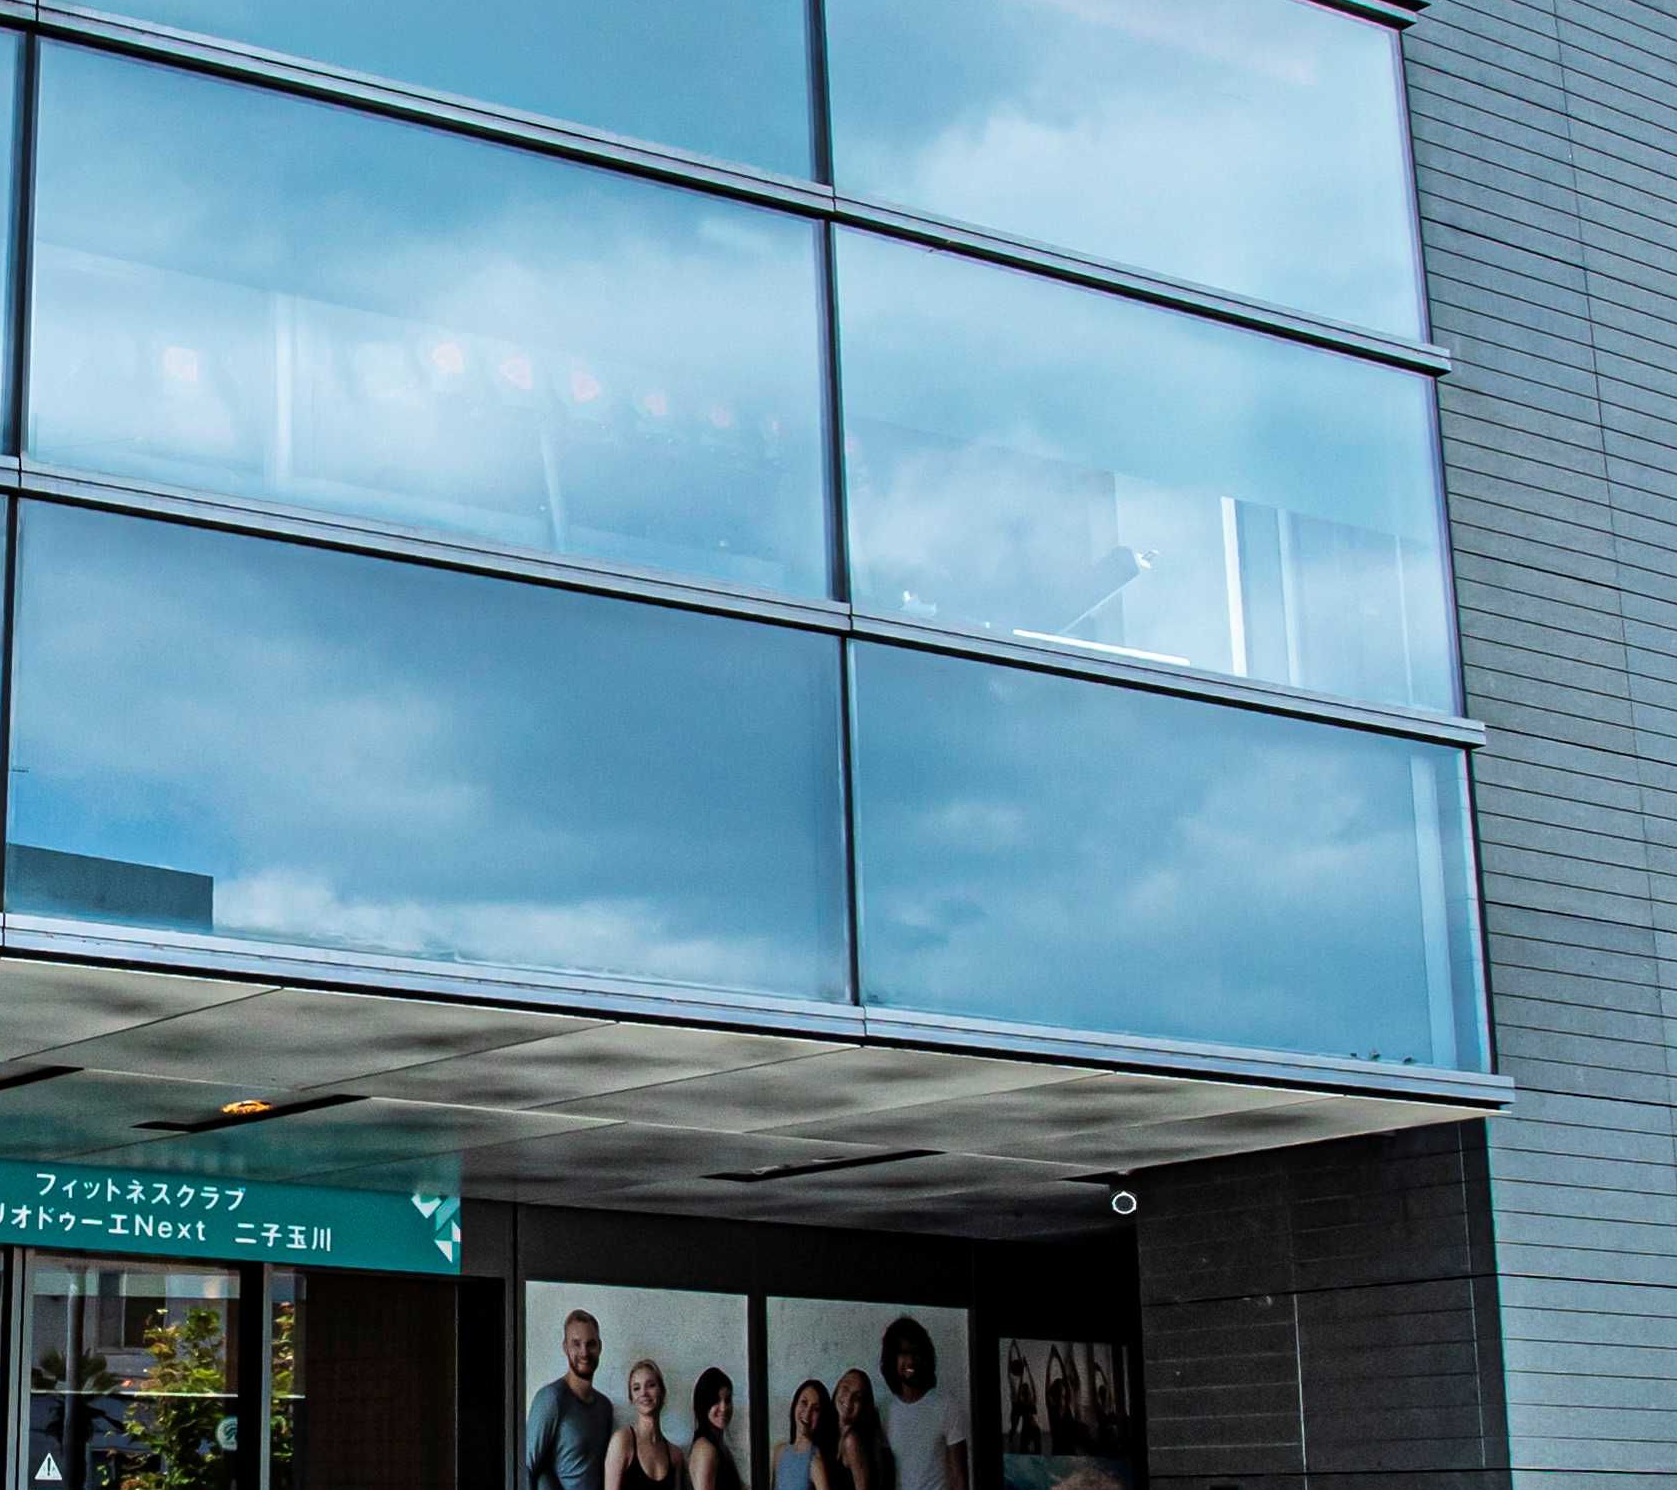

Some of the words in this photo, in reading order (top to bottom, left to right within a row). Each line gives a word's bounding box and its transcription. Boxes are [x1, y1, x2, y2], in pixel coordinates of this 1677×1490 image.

[36, 1173, 246, 1211] フィットネスクラブ
[234, 1221, 333, 1252] 二子玉川
